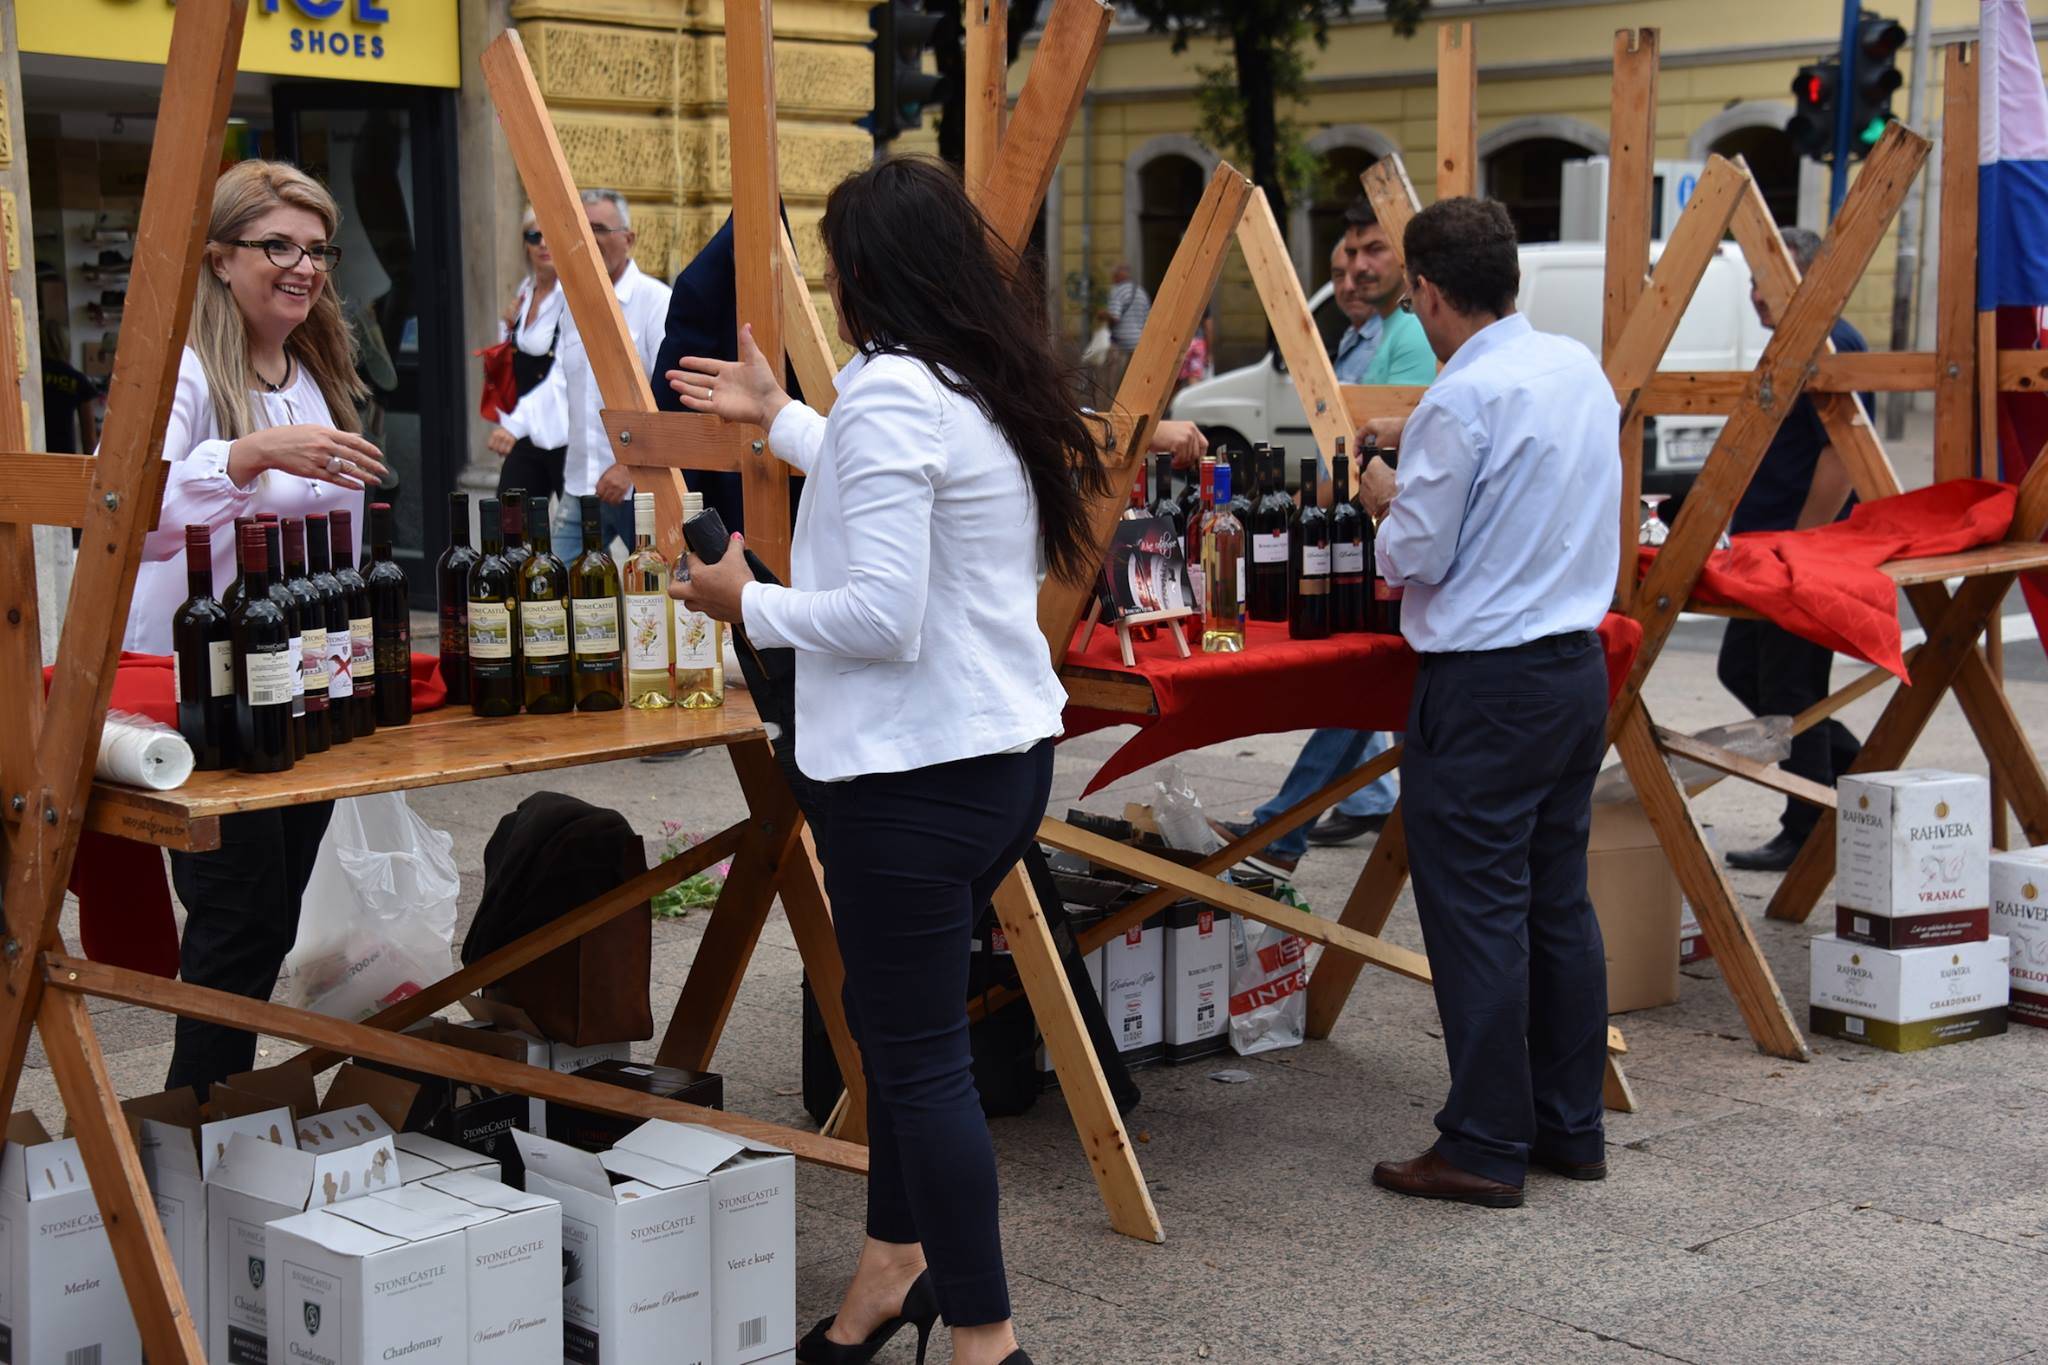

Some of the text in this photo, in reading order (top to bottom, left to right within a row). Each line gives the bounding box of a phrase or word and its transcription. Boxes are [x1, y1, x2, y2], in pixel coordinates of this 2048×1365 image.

[290, 28, 384, 59] SHOES
[1843, 809, 1883, 828] RAHVERA
[1910, 823, 1973, 841] RAHVERA
[1919, 889, 1966, 902] VRANAC
[463, 1117, 517, 1140] STONECASTLE
[718, 1187, 780, 1210] STONECASTLE
[631, 1216, 696, 1240] STONECASTLE
[476, 1240, 545, 1268] STONECASTLE
[64, 1279, 101, 1296] Merlot
[374, 1265, 447, 1295] STONECASTLE
[383, 1335, 444, 1361] Chardonnay
